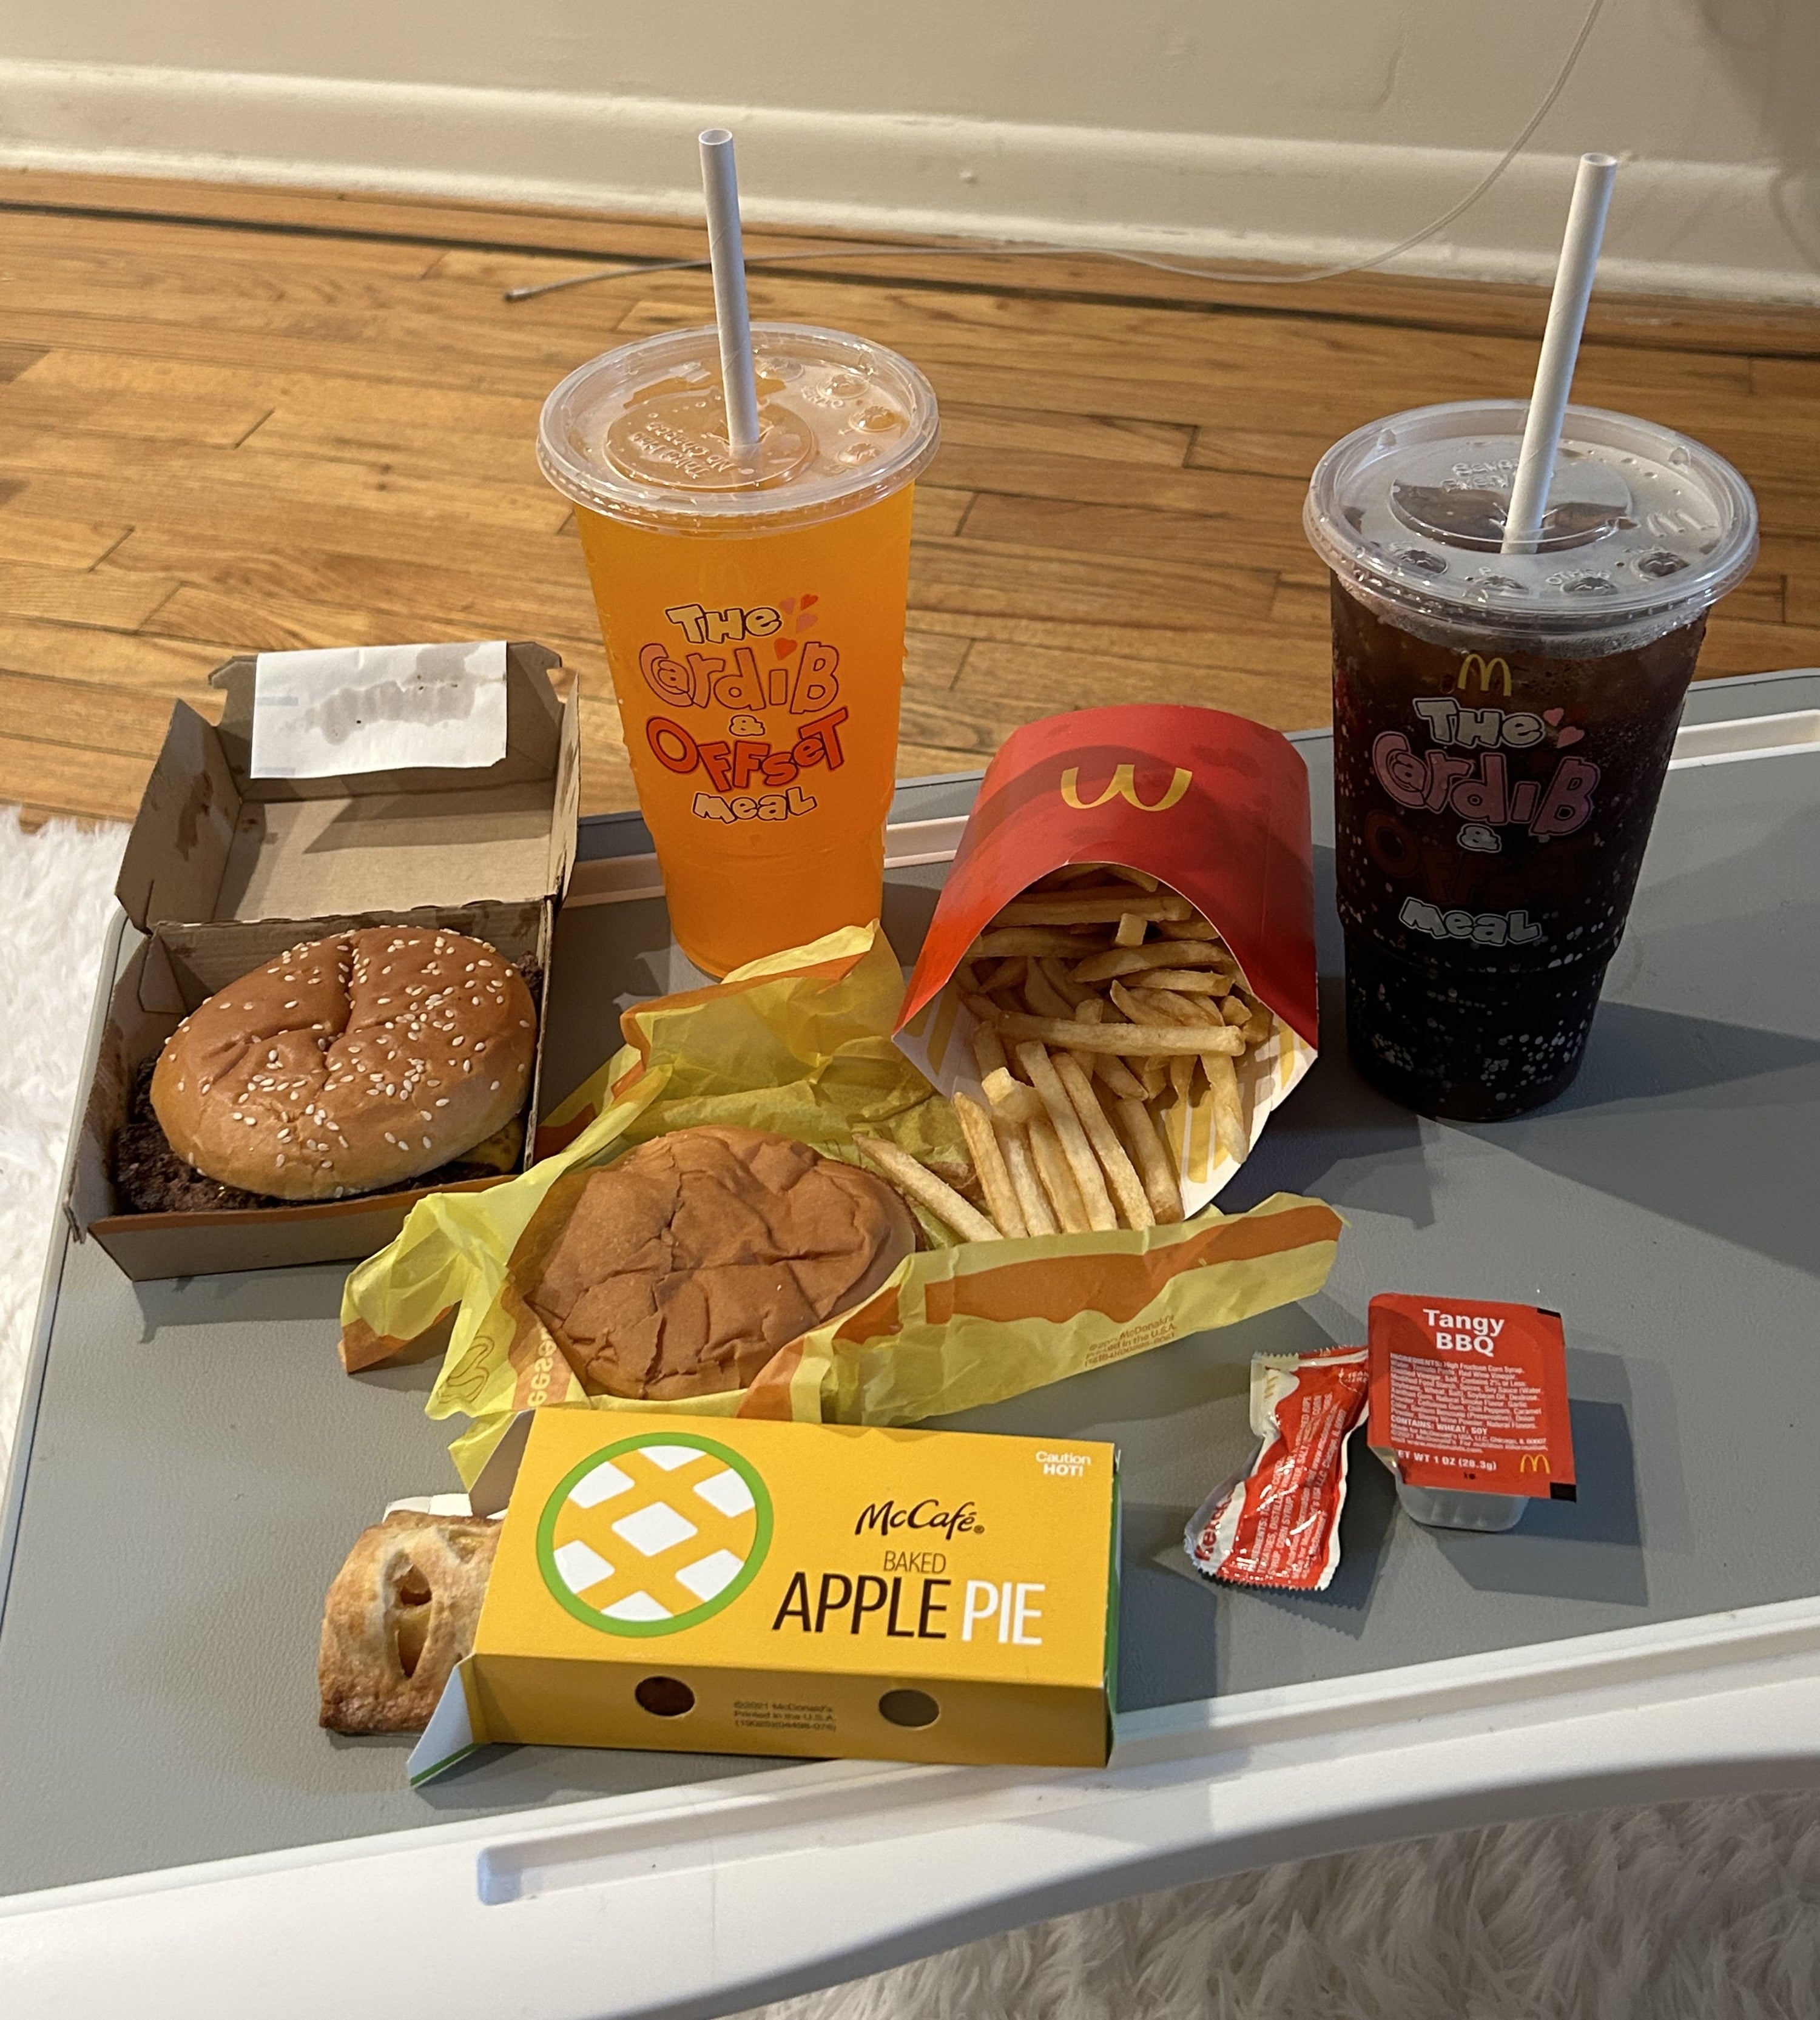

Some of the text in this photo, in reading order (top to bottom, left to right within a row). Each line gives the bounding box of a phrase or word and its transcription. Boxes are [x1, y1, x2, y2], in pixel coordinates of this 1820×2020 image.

[729, 715, 766, 737] &
[1423, 1308, 1505, 1337] Tangy
[1436, 1332, 1494, 1358] BBQ
[1471, 1426, 1488, 1435] SOY
[1036, 1450, 1091, 1466] Caution
[1397, 1449, 1410, 1459] ET
[1414, 1452, 1431, 1463] WT
[1458, 1457, 1497, 1472] (28.3g)
[1043, 1463, 1084, 1477] HOT!
[883, 1550, 946, 1574] BAKED
[772, 1571, 1045, 1645] APPLE PIE
